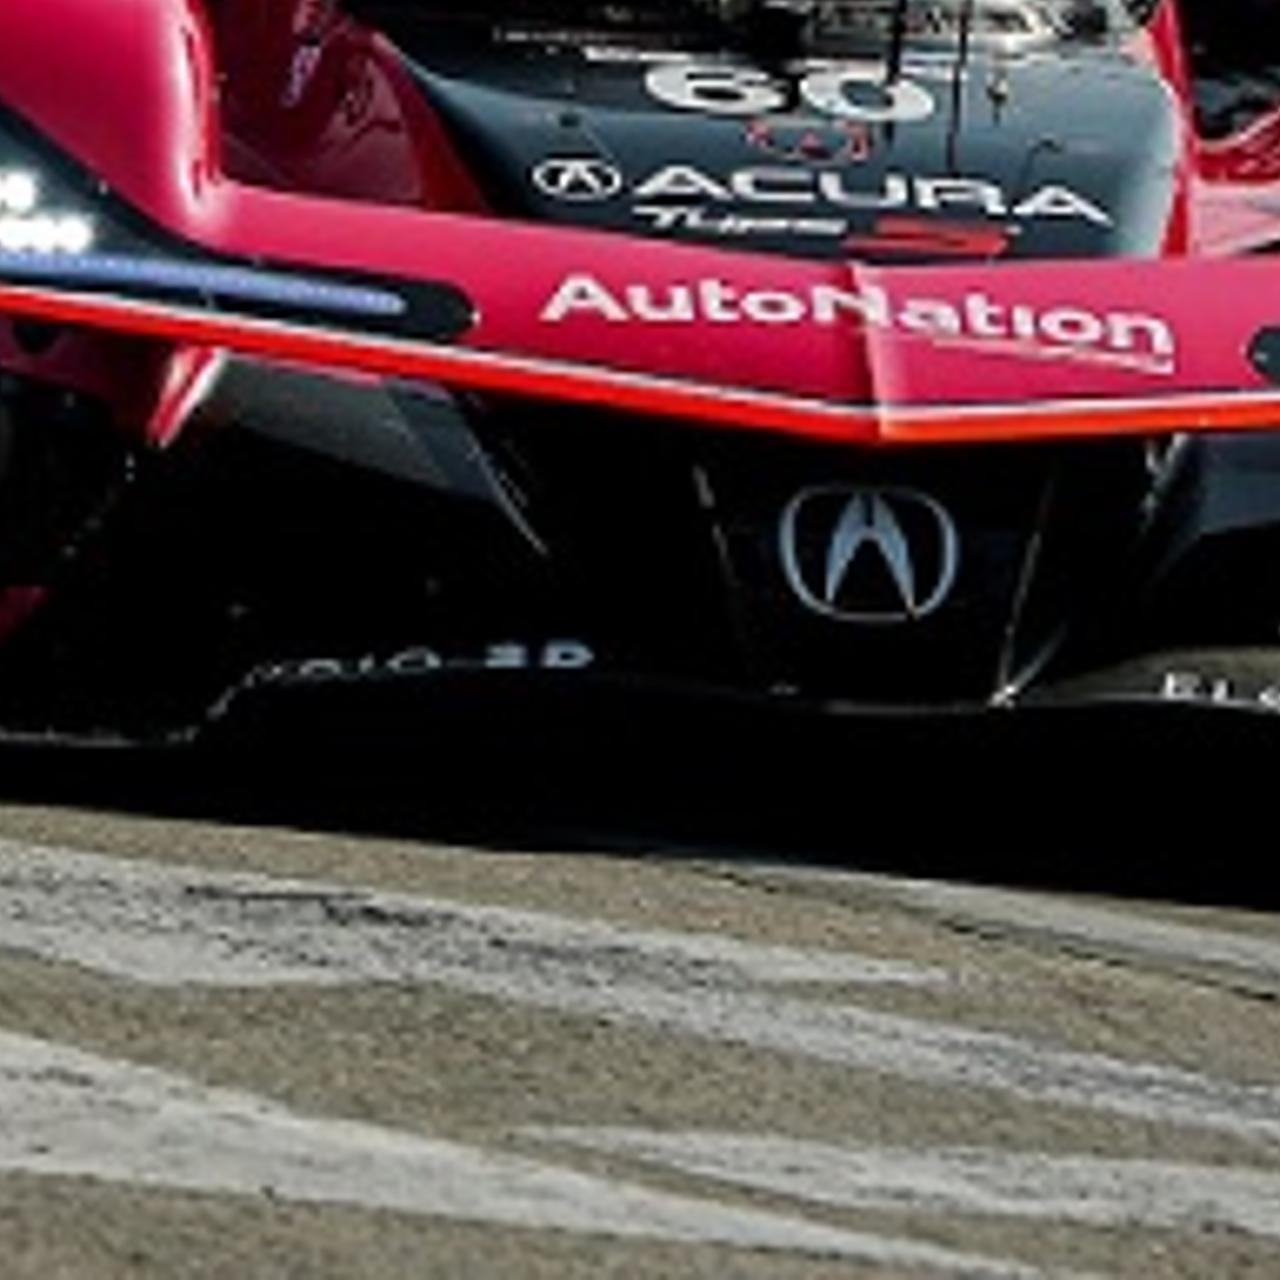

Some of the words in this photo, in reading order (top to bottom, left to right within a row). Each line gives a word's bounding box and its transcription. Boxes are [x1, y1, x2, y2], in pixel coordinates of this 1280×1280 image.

[643, 58, 938, 122] 60
[632, 163, 1115, 232] ACURA
[540, 273, 1176, 355] AutoNation
